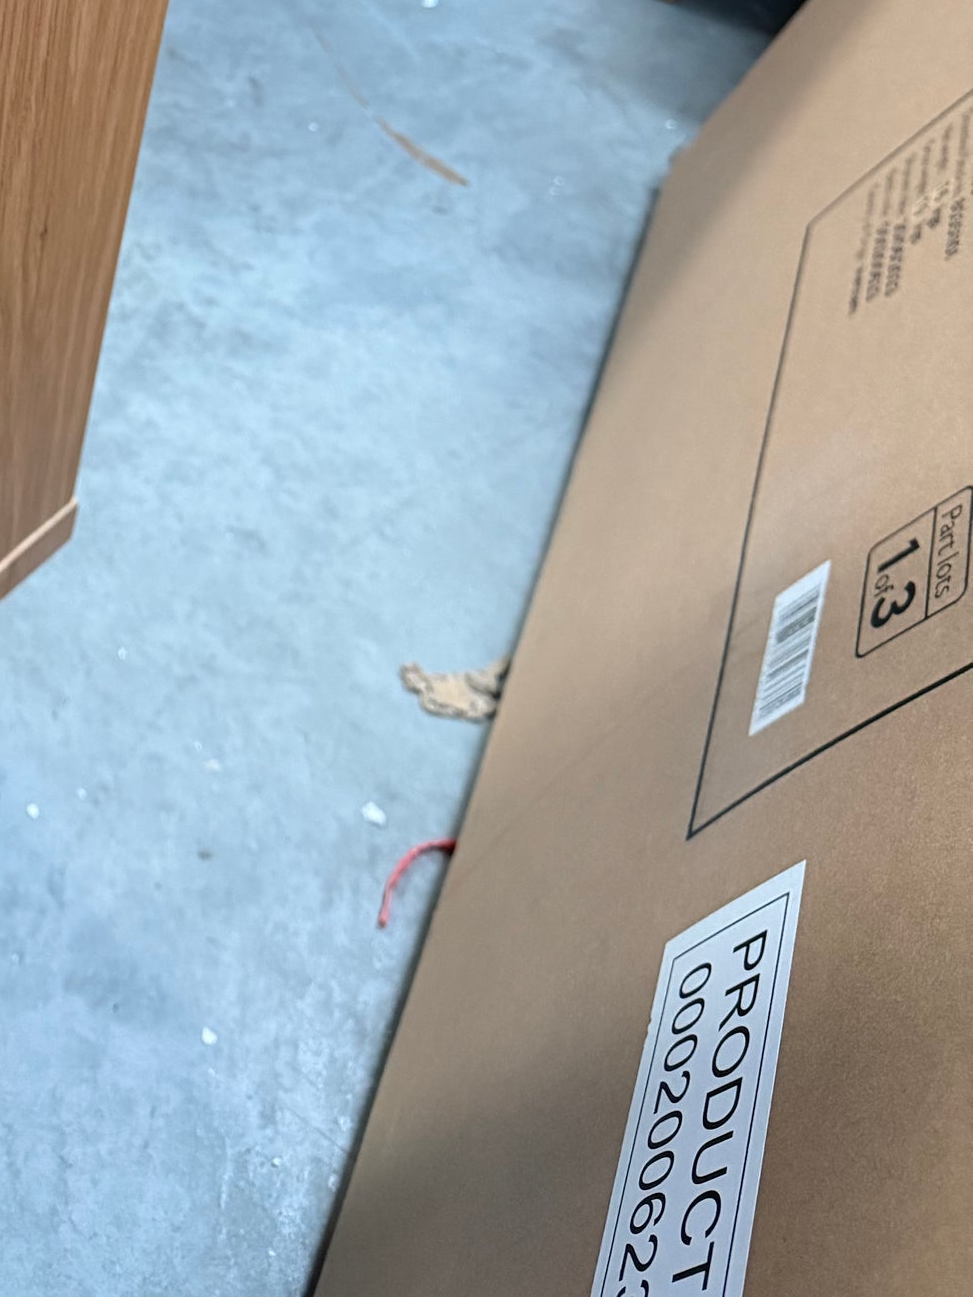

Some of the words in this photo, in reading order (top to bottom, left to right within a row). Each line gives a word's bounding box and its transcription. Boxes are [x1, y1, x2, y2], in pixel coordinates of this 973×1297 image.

[938, 503, 963, 556] Part
[878, 537, 920, 573] 1
[934, 551, 960, 599] lots
[870, 580, 916, 629] 3
[873, 573, 895, 598] of
[671, 929, 768, 1291] PRODUCT
